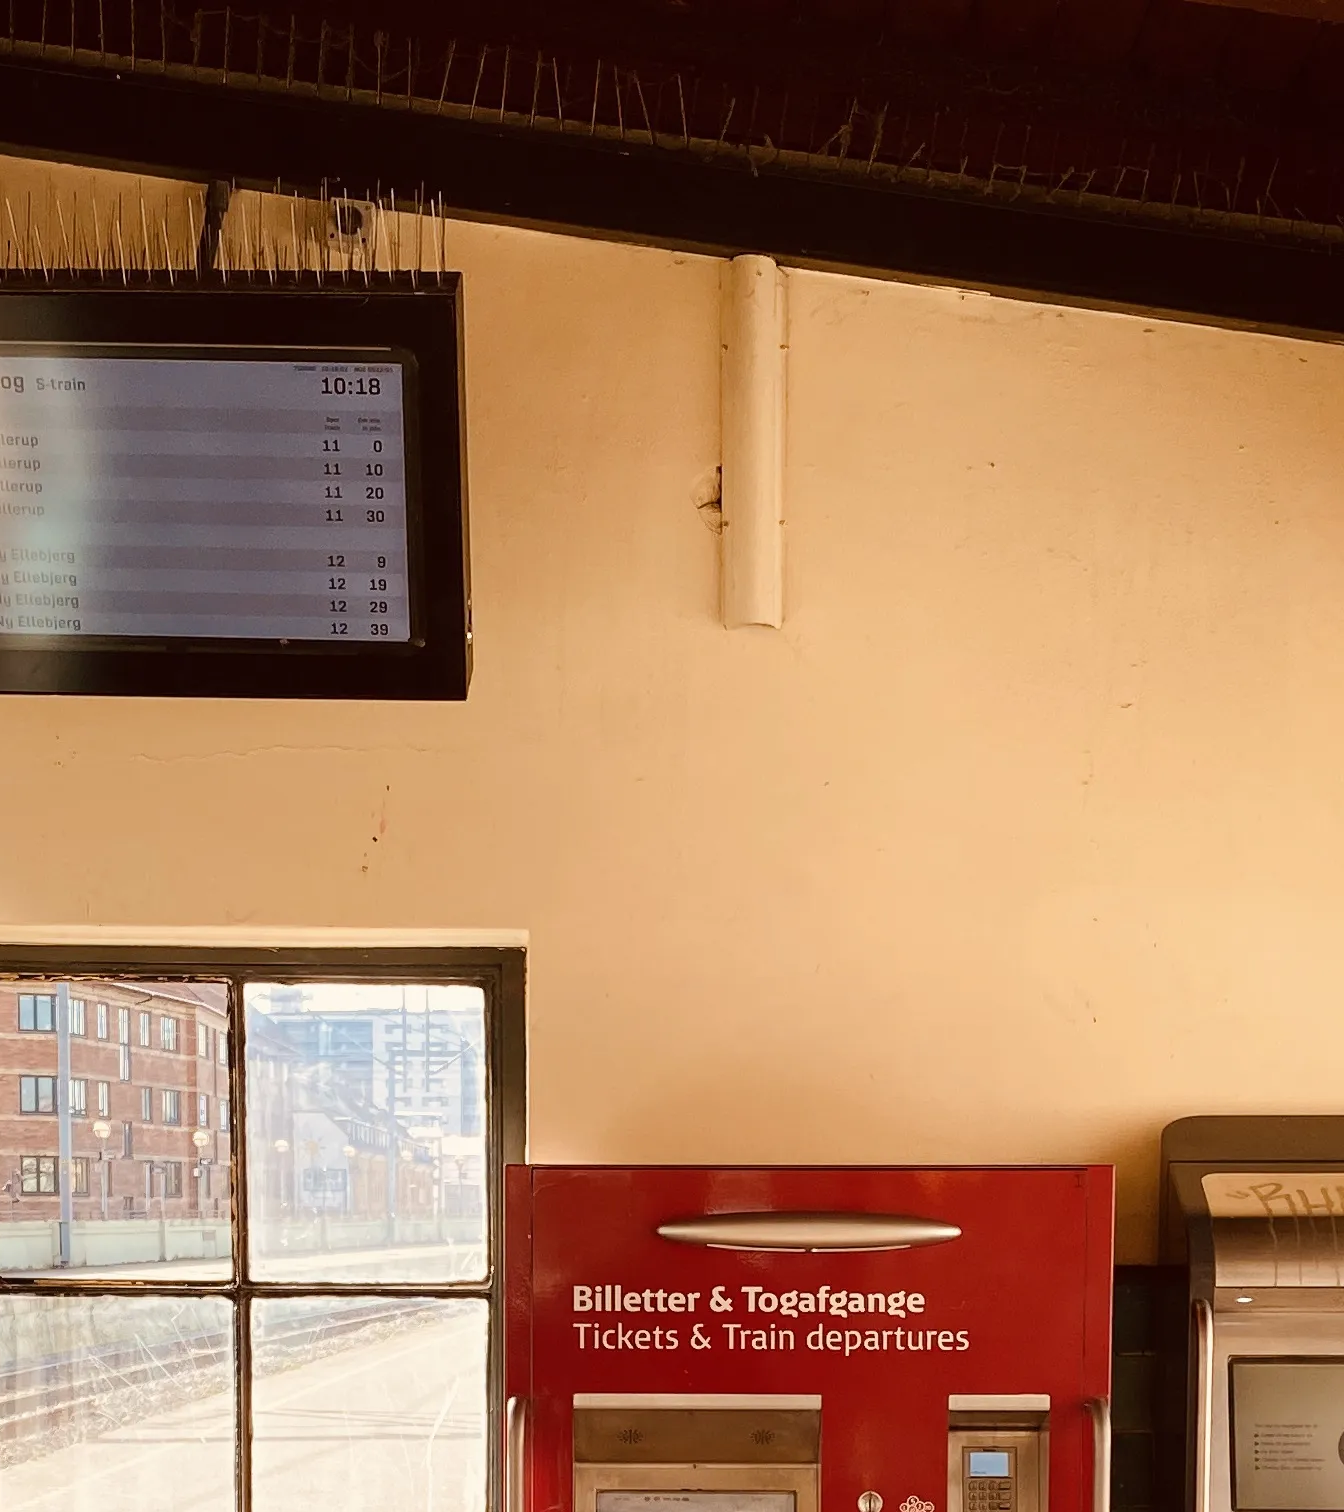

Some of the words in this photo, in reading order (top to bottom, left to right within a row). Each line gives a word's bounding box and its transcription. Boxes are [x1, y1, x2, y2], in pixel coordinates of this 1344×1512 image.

[37, 378, 86, 391] S-train
[321, 377, 380, 395] 10:18
[323, 440, 340, 451] 11
[374, 440, 382, 452] 0
[324, 463, 341, 475] 11
[366, 464, 383, 476] 10
[325, 486, 342, 498] 11
[366, 487, 383, 499] 20
[326, 510, 343, 521] 11
[366, 510, 384, 522] 30
[11, 548, 74, 563] Ellebjerg
[328, 556, 345, 567] 12
[377, 556, 386, 568] 9
[14, 571, 77, 586] Ellebjerg
[329, 578, 346, 589] 12
[370, 579, 386, 590] 19
[16, 594, 78, 608] Ellebjerg
[330, 601, 347, 612] 12
[370, 601, 387, 613] 29
[18, 616, 81, 630] Ellebjerg
[331, 623, 348, 634] 12
[371, 624, 388, 635] 39
[573, 1286, 700, 1312] Billetter
[710, 1286, 733, 1313] &
[742, 1285, 926, 1318] Togafgange
[574, 1324, 678, 1350] Tickets
[690, 1324, 712, 1350] &
[722, 1324, 796, 1351] Train
[806, 1324, 970, 1356] departures
